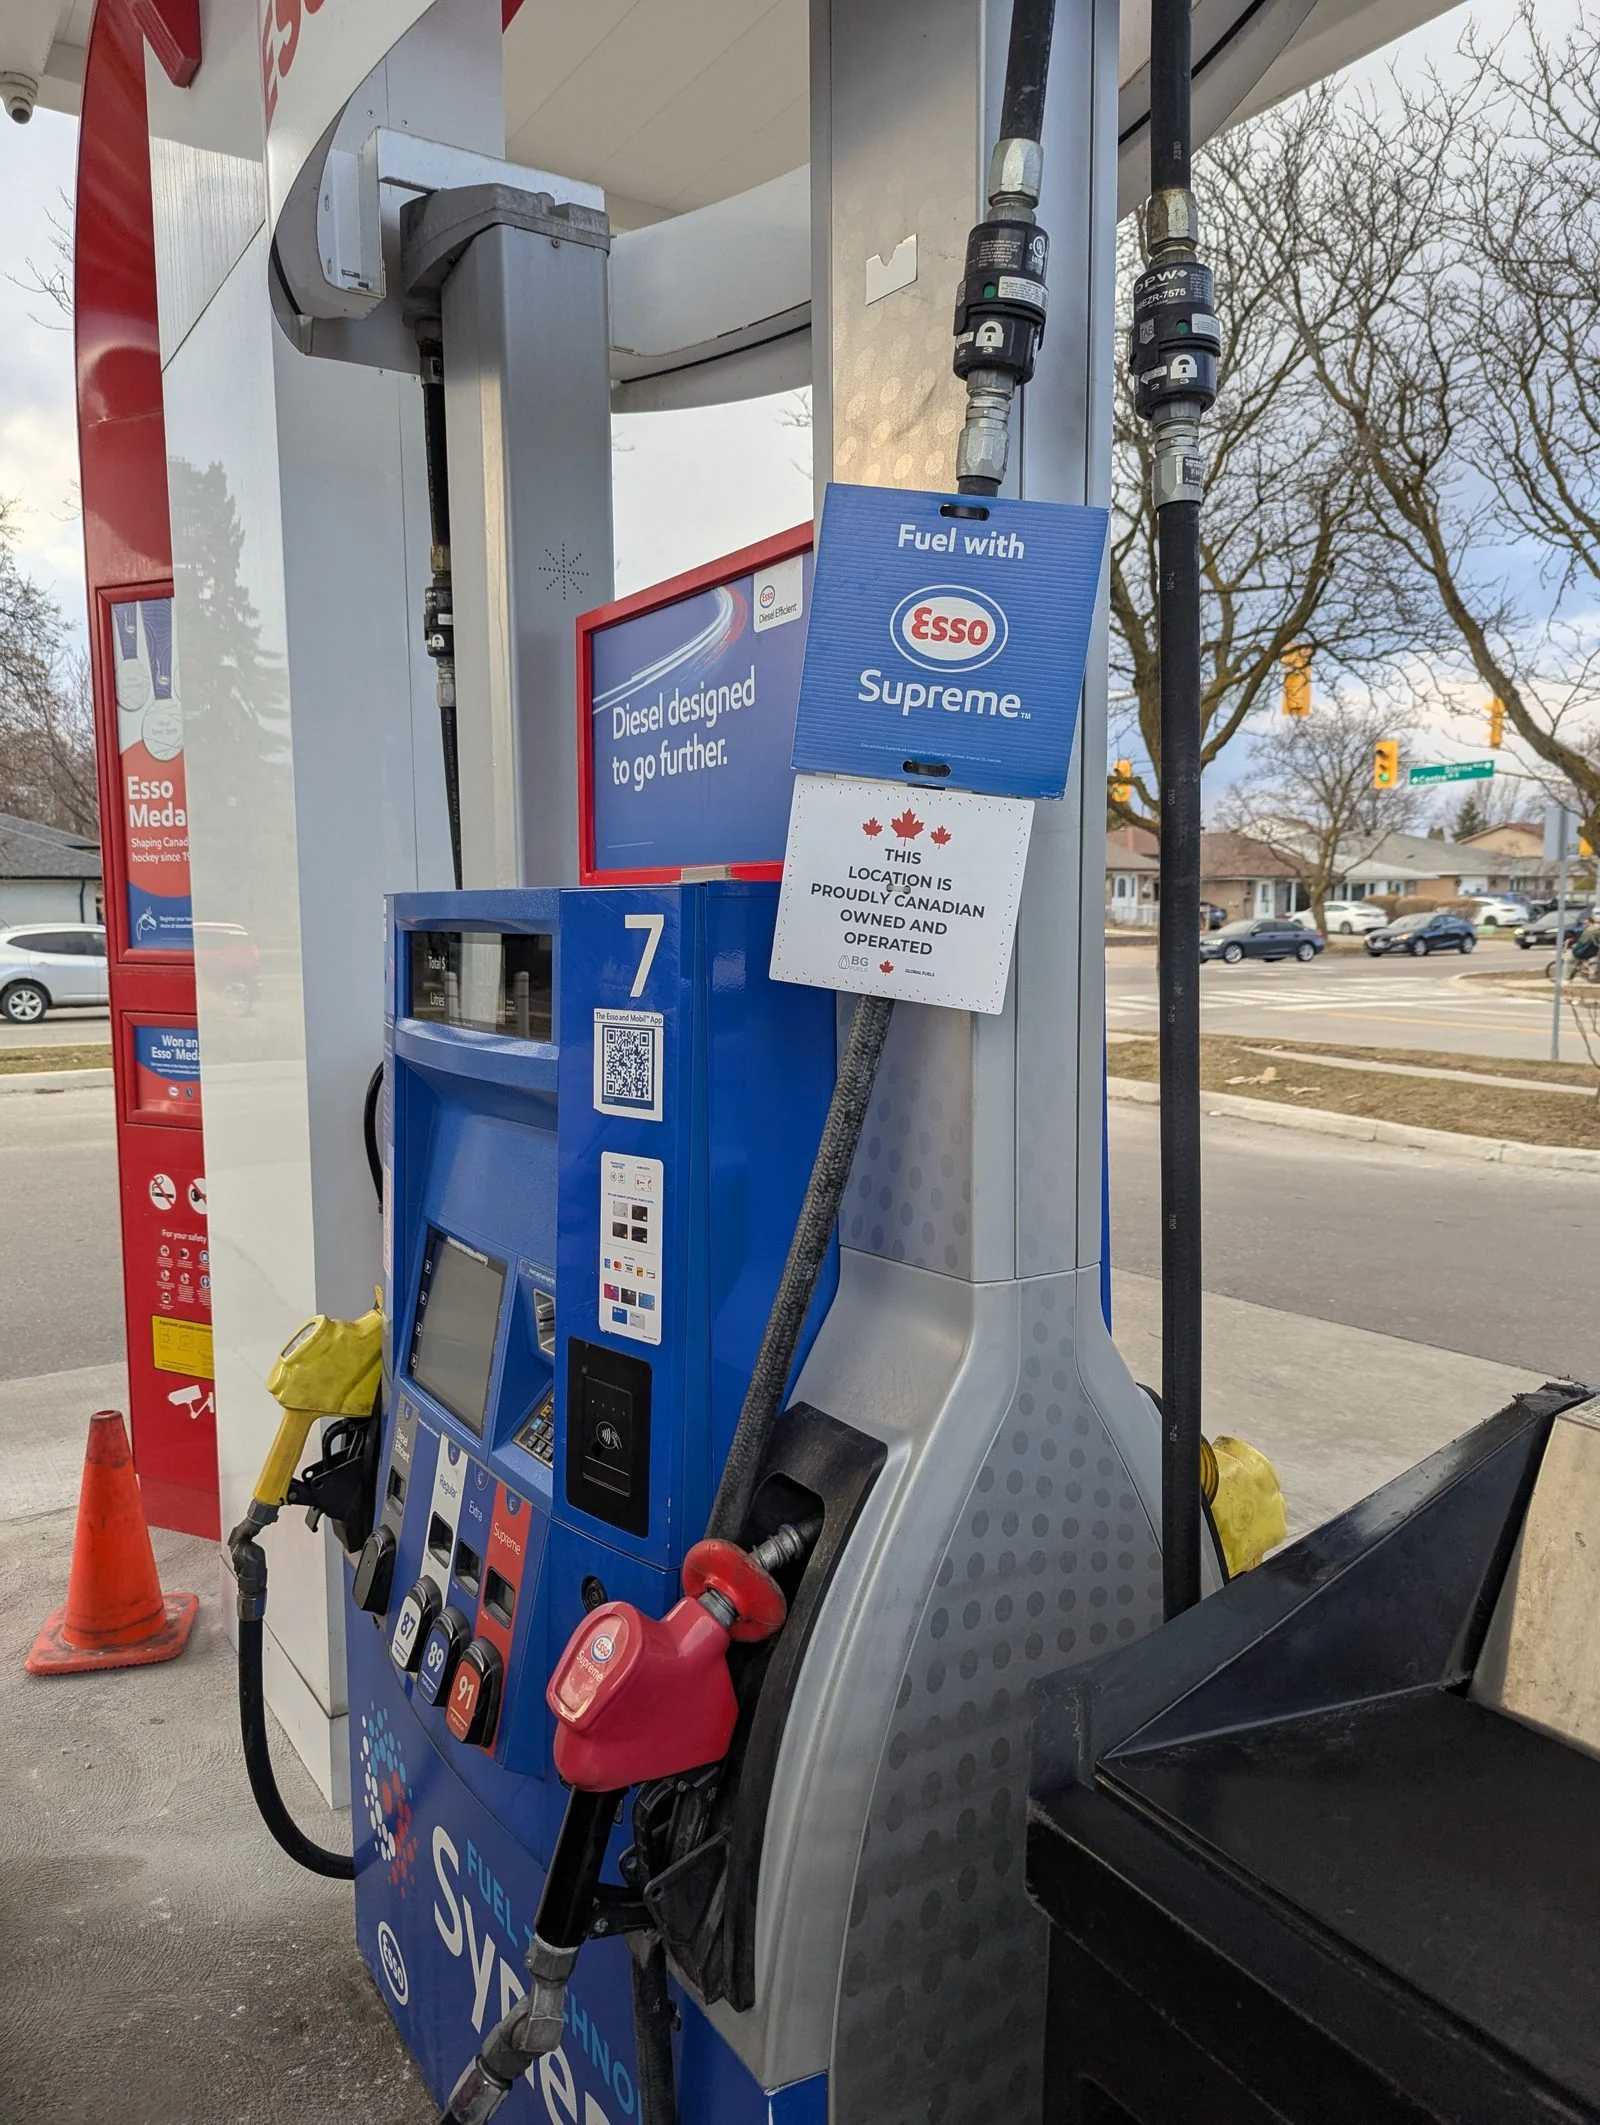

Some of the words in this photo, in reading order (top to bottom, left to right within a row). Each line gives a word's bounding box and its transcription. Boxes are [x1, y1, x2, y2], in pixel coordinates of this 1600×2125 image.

[898, 524, 957, 552] Fuel
[964, 531, 1025, 559] with
[759, 609, 775, 624] Diesel
[911, 607, 989, 646] Esso
[613, 692, 663, 740] Diesel
[668, 664, 756, 728] designed
[612, 757, 630, 785] to
[634, 755, 656, 791] go
[660, 733, 728, 777] further.
[127, 776, 173, 800] Esso
[129, 802, 187, 828] Meda
[131, 838, 162, 850] Shaping
[163, 836, 189, 848] Canad
[132, 853, 159, 864] hockey
[161, 852, 180, 861] since
[885, 848, 922, 865] THIS
[848, 866, 932, 889] LOCATION
[937, 877, 952, 891] IS
[811, 883, 891, 905] PROUDLY
[894, 894, 985, 918] CANADIAN
[840, 909, 905, 930] OWNED
[909, 919, 948, 935] AND
[843, 931, 933, 955] OPERATED
[428, 956, 441, 969] Total
[625, 914, 664, 997] 7
[851, 955, 869, 967] BG
[430, 992, 445, 1007] Litres
[606, 1013, 619, 1021] Esso
[650, 1016, 662, 1025] App
[162, 1035, 184, 1047] Won
[186, 1039, 198, 1048] an
[176, 1048, 199, 1060] Med
[162, 1229, 173, 1238] For
[173, 1232, 187, 1240] your
[439, 1474, 457, 1498] Regular
[468, 1500, 483, 1522] Extra
[493, 1522, 521, 1555] Supreme
[401, 1611, 416, 1640] 87
[428, 1641, 444, 1672] 89
[576, 1650, 603, 1682] Supreme
[457, 1675, 475, 1710] 91
[467, 1839, 519, 1948] FUEL
